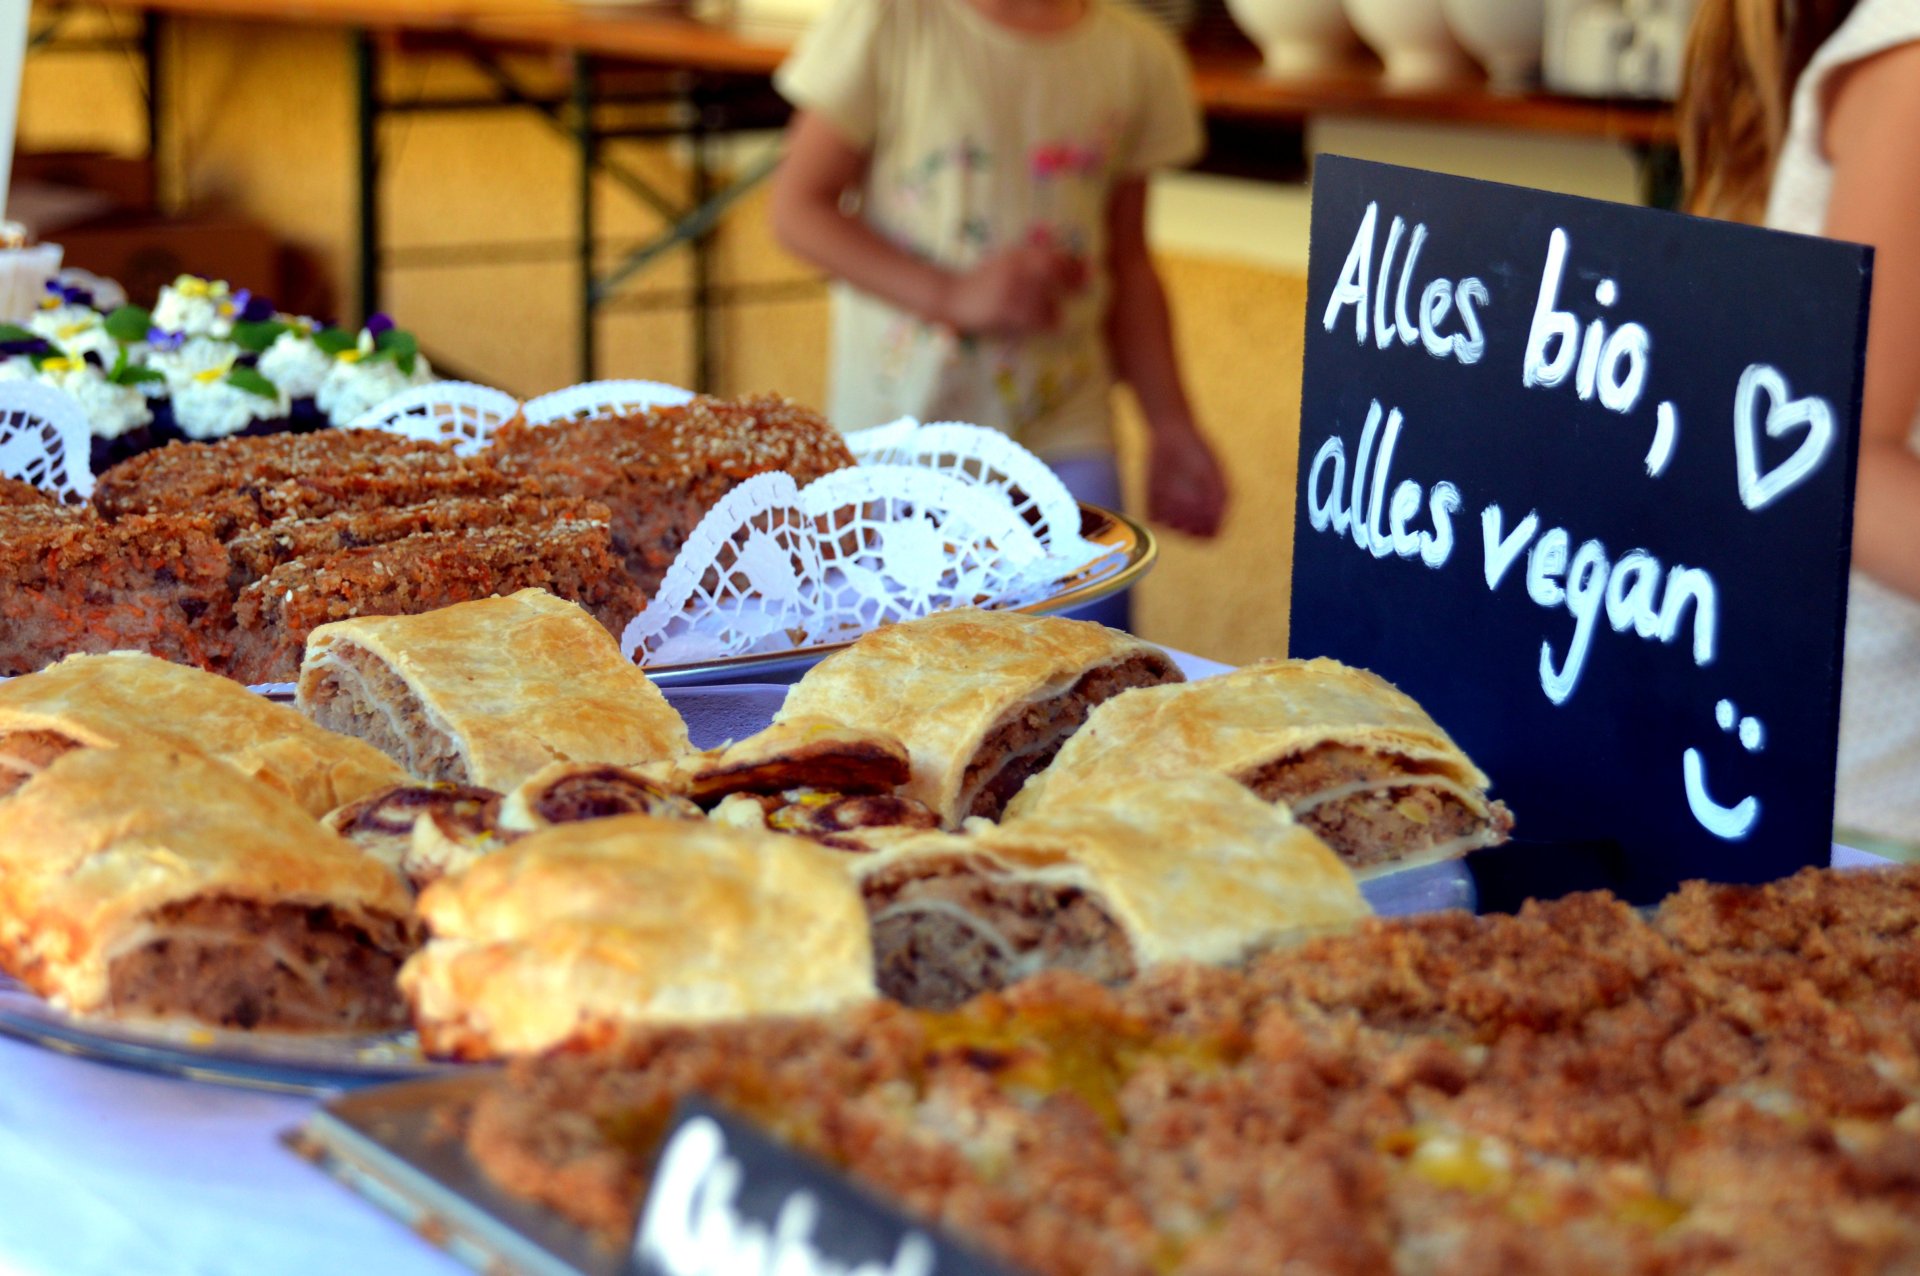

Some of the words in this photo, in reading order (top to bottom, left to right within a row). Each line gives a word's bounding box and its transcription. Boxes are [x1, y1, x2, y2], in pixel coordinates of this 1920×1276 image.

[1322, 200, 1490, 366] Alles
[1522, 227, 1679, 478] bio,
[1307, 398, 1463, 569] alles
[1481, 503, 1717, 705] vegan
